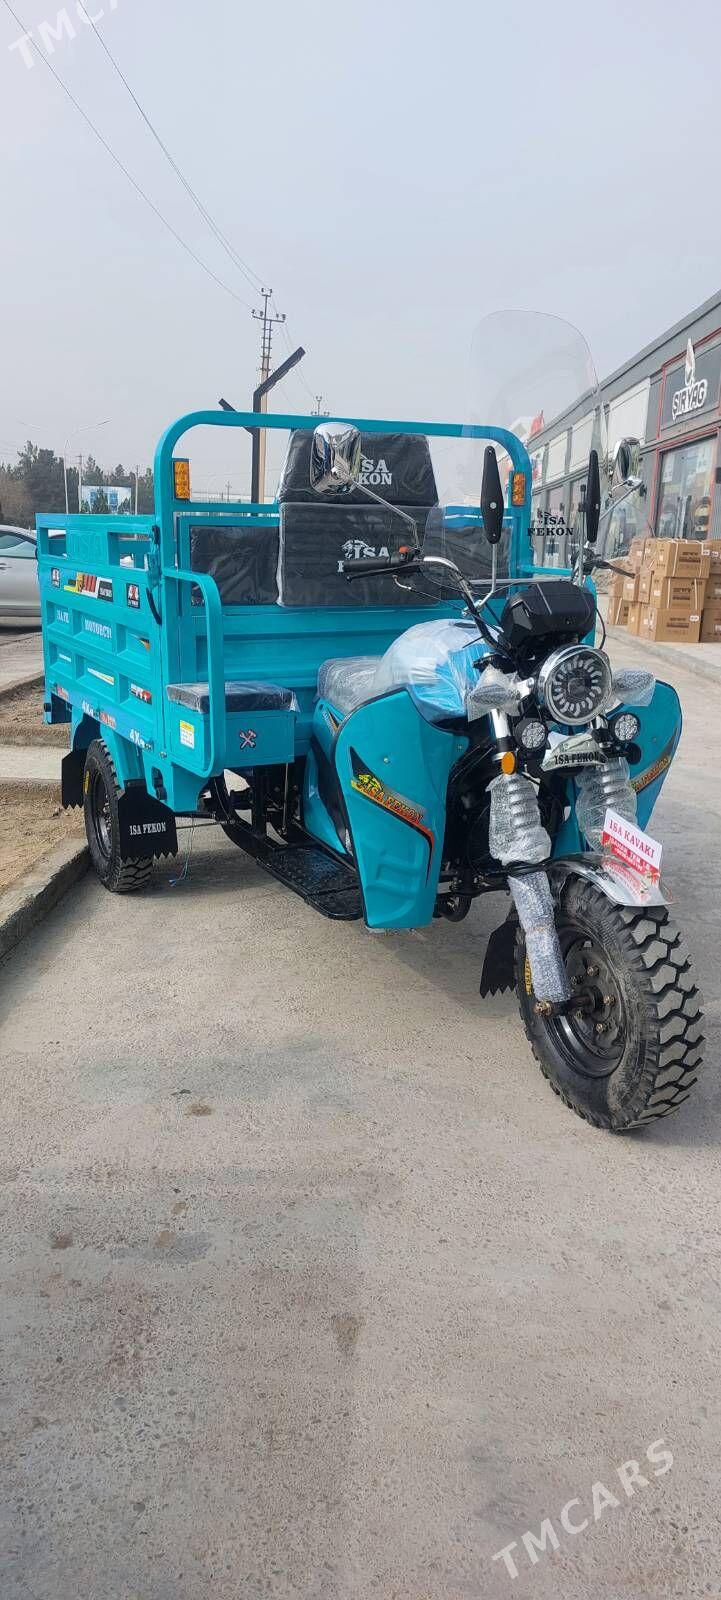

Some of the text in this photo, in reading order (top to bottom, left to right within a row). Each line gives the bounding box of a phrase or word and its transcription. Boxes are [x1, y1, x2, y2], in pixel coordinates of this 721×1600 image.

[544, 516, 565, 525] ISA
[527, 527, 574, 537] FEKON
[354, 546, 389, 559] ISA
[129, 822, 166, 835] ISA FEKON
[609, 819, 622, 835] ISA
[624, 830, 655, 859] KAVAKI
